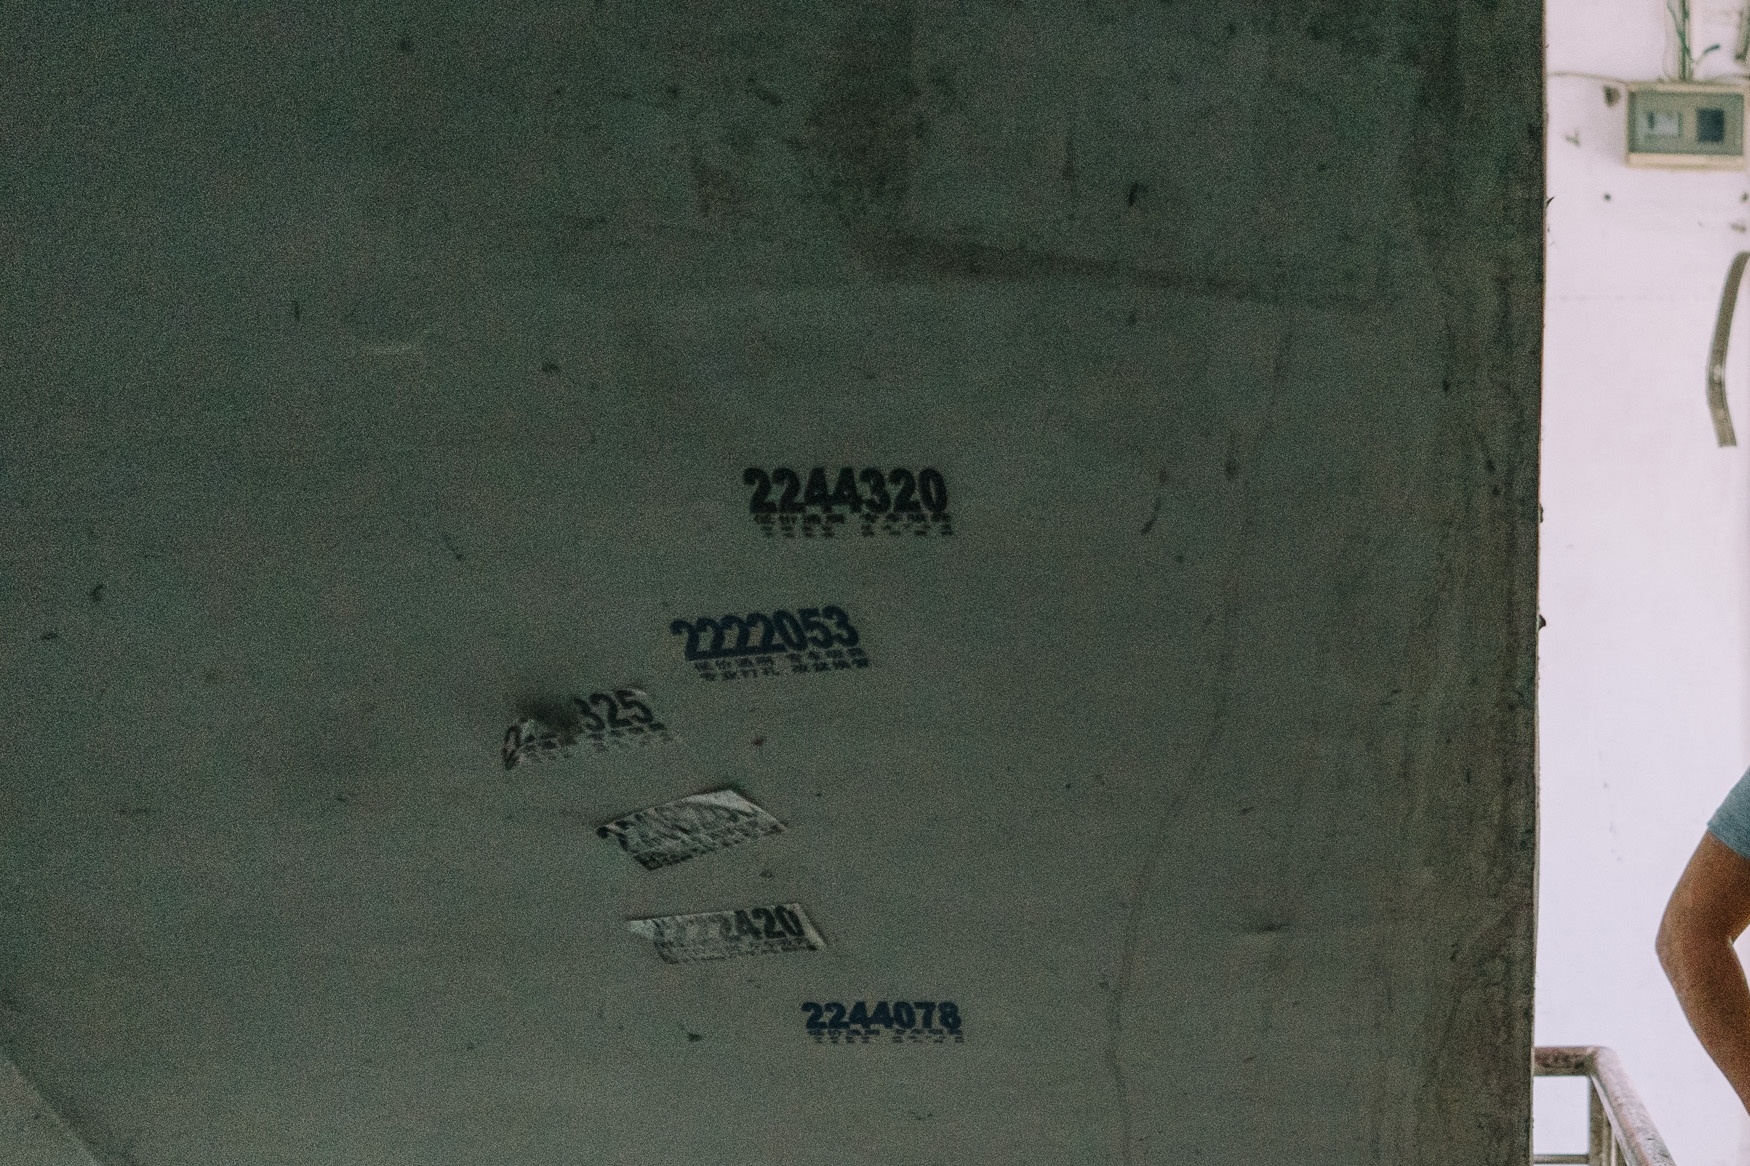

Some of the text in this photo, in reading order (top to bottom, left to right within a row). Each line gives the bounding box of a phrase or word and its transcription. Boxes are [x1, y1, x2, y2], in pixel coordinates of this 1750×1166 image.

[742, 466, 948, 514] 2244320
[669, 604, 859, 661] 2222053
[801, 1000, 962, 1030] 2244078
